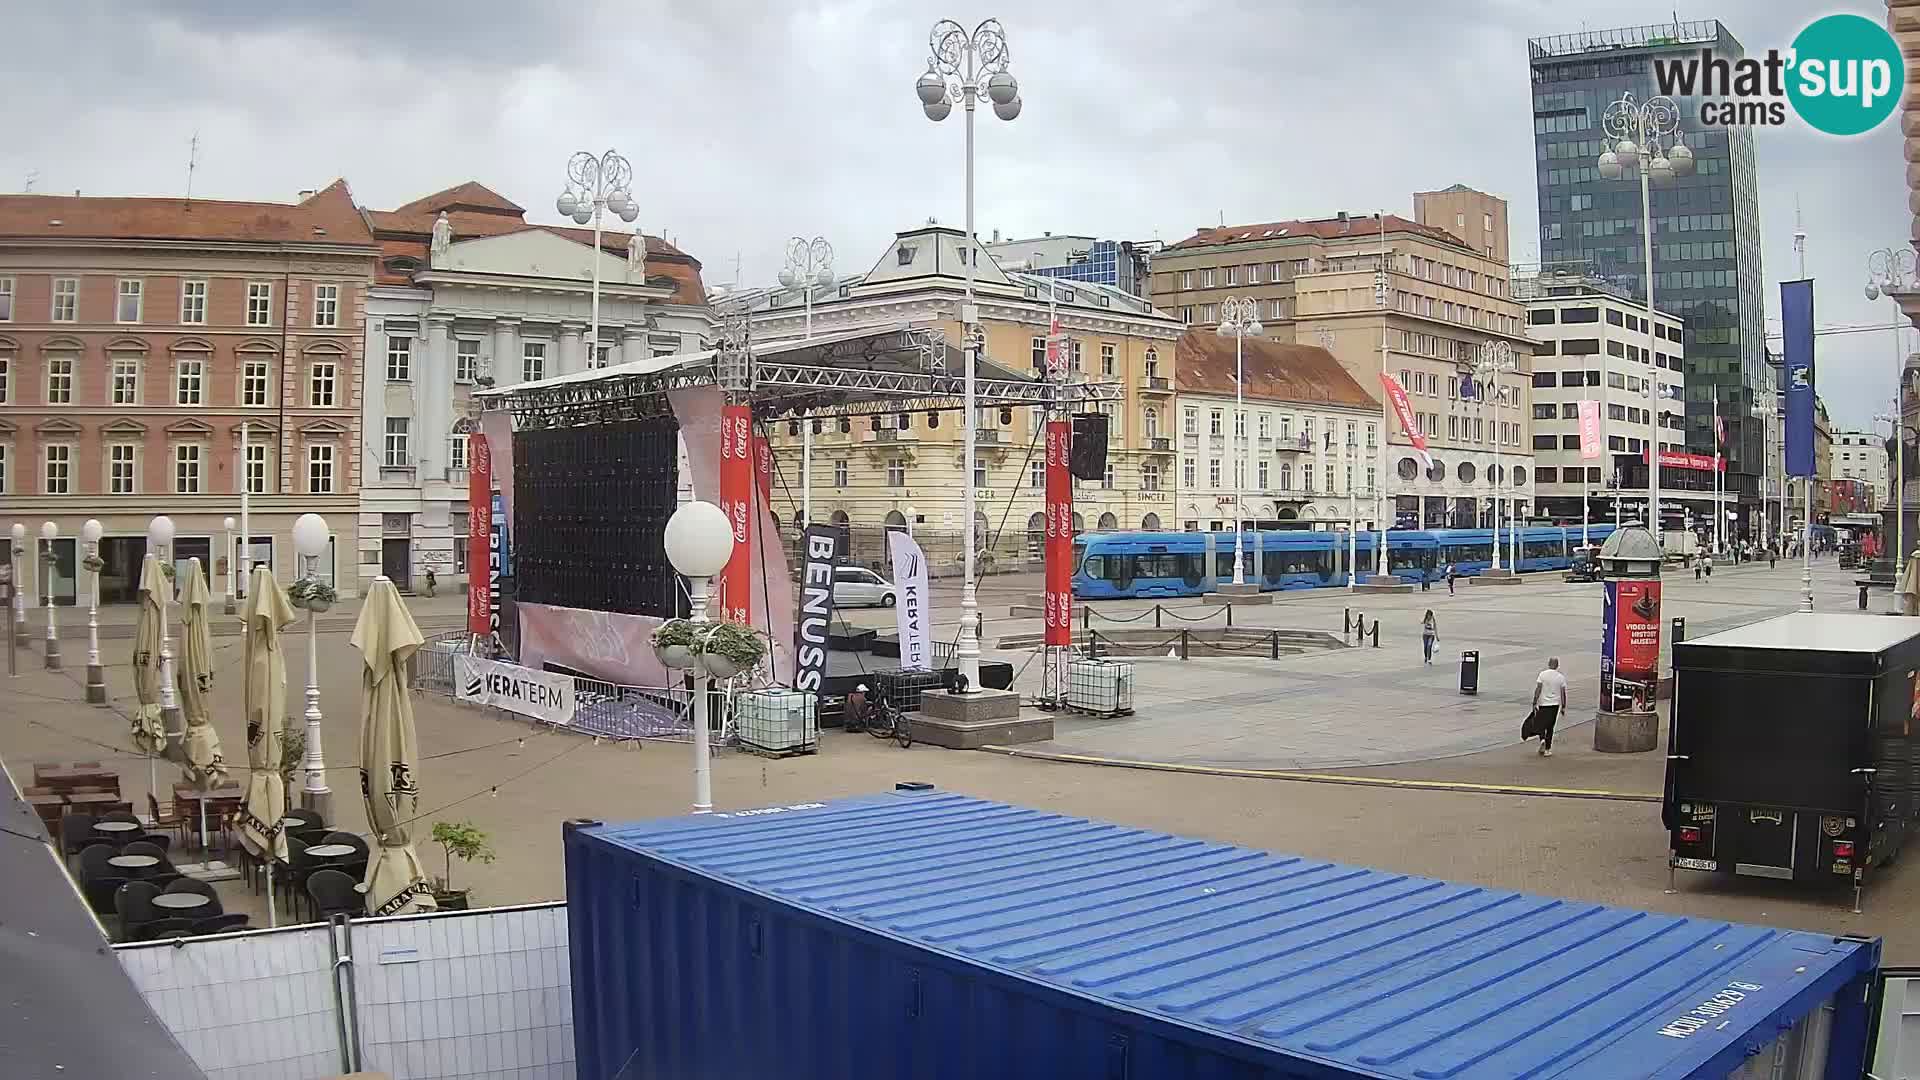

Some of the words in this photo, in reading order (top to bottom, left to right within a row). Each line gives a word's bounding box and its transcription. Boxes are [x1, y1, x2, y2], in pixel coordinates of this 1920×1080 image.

[961, 490, 995, 498] SGER
[1625, 623, 1646, 631] VIDEO
[485, 671, 563, 710] KERATERM
[1657, 1016, 1708, 1039] MCDU
